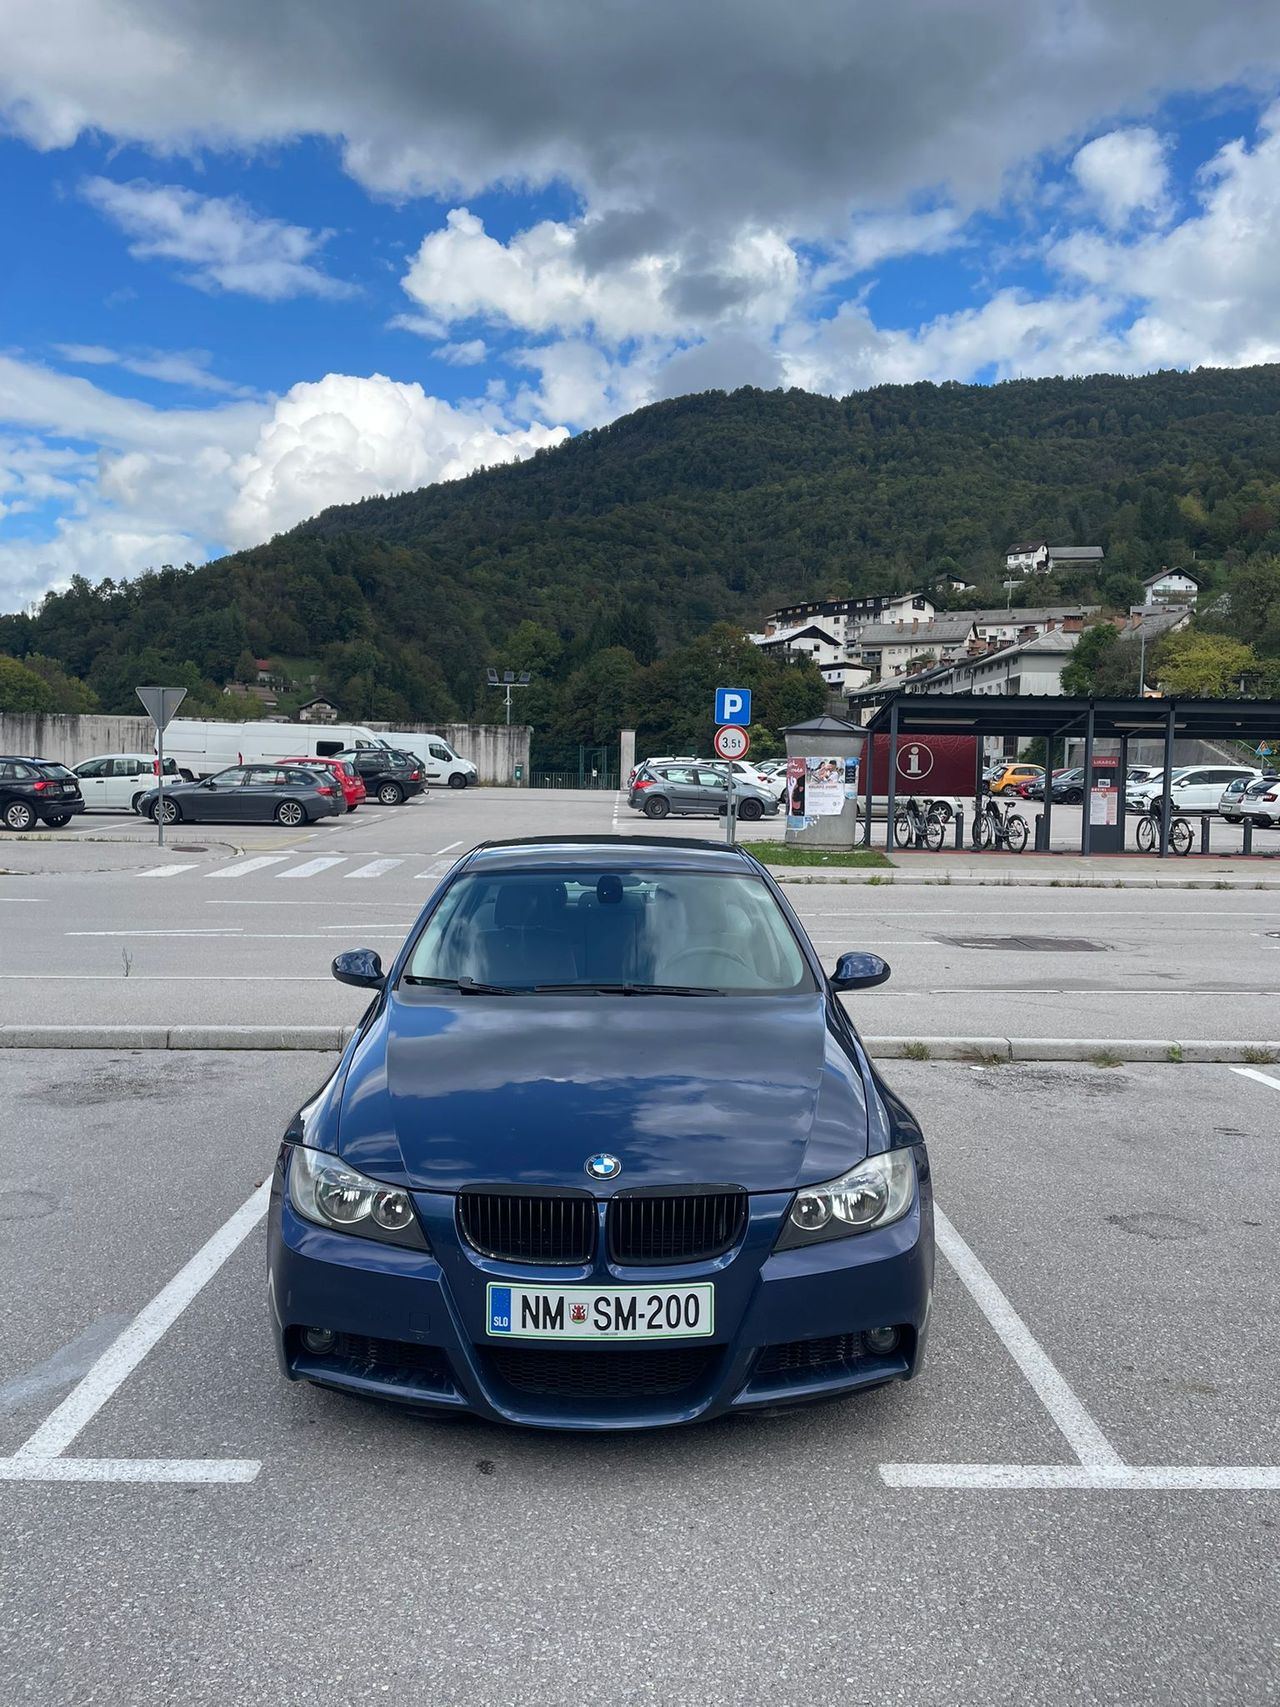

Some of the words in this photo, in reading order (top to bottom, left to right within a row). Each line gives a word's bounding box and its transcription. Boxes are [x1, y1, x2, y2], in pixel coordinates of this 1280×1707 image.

[723, 693, 743, 720] P
[493, 1316, 509, 1328] SLO
[521, 1294, 565, 1331] NM
[593, 1293, 700, 1332] SM-200
